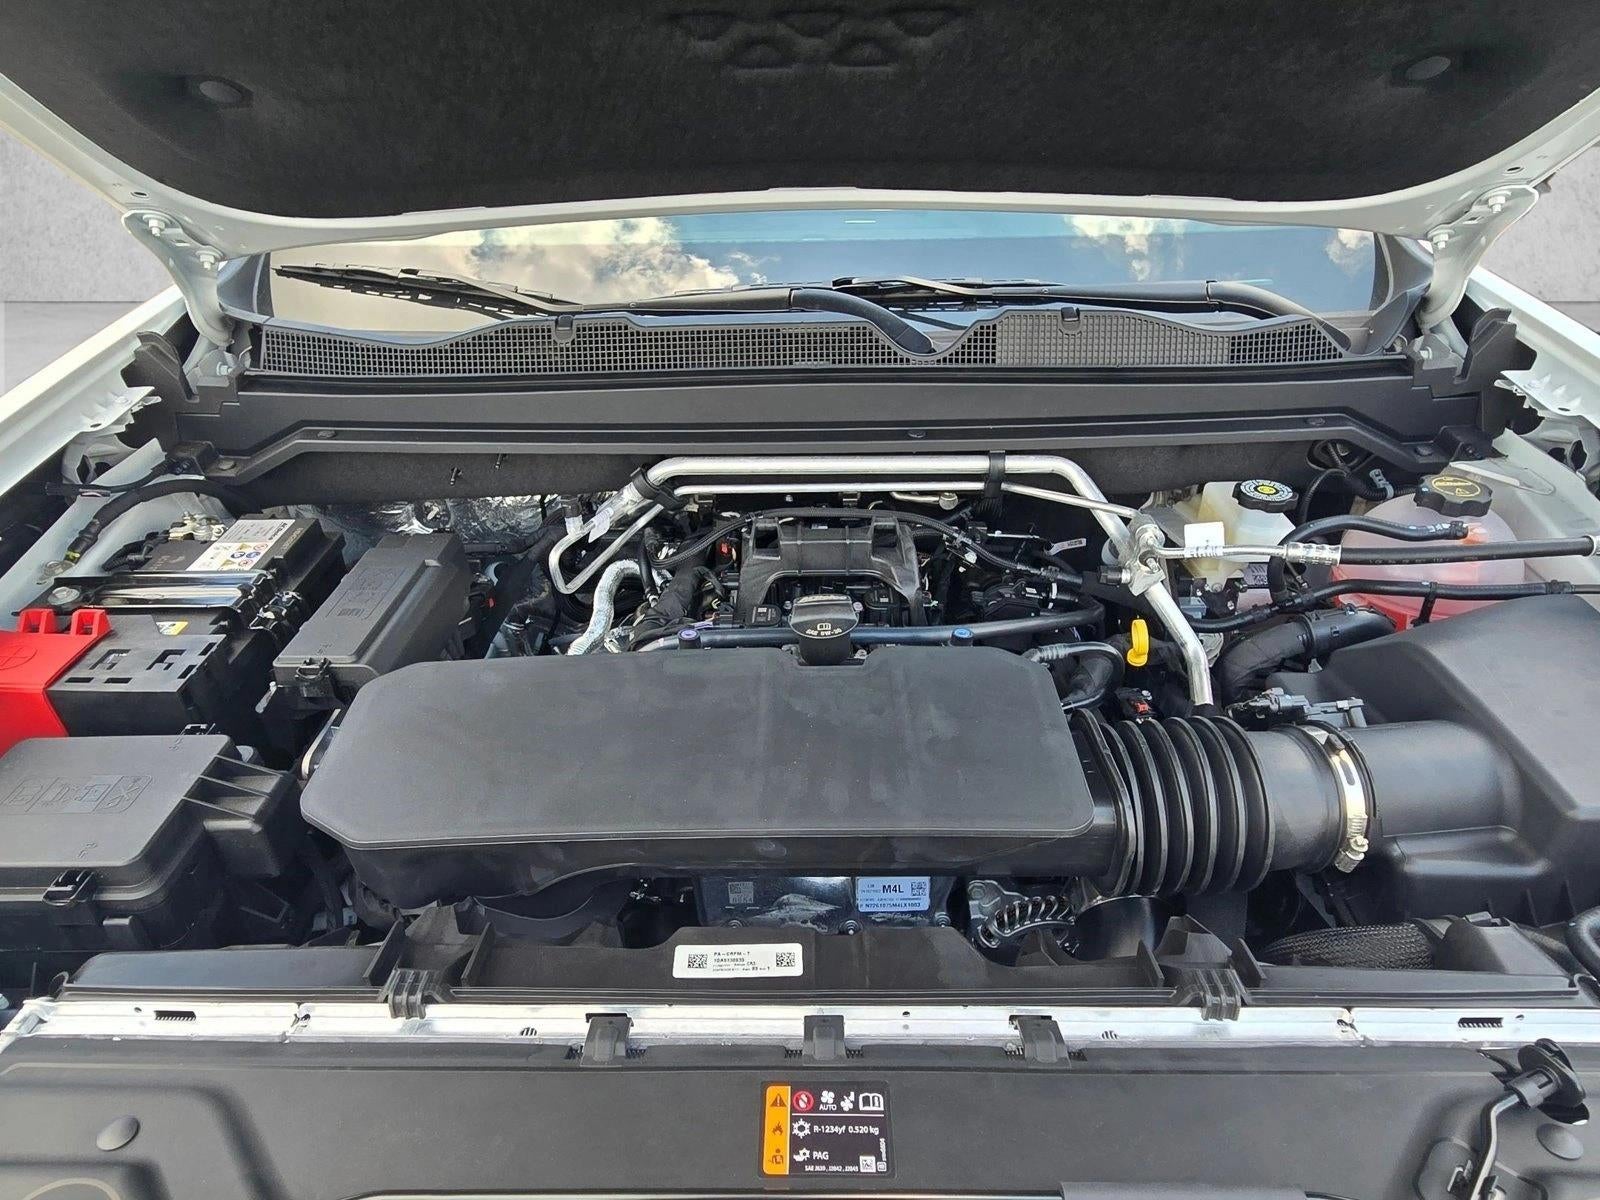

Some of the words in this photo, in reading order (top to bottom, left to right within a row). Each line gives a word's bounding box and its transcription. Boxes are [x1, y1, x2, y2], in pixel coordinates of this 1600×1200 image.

[882, 884, 904, 894] M4L
[813, 1125, 846, 1135] R-1234yf
[848, 1125, 869, 1134] 0.520
[869, 1125, 880, 1135] kg
[812, 1151, 829, 1160] PAG
